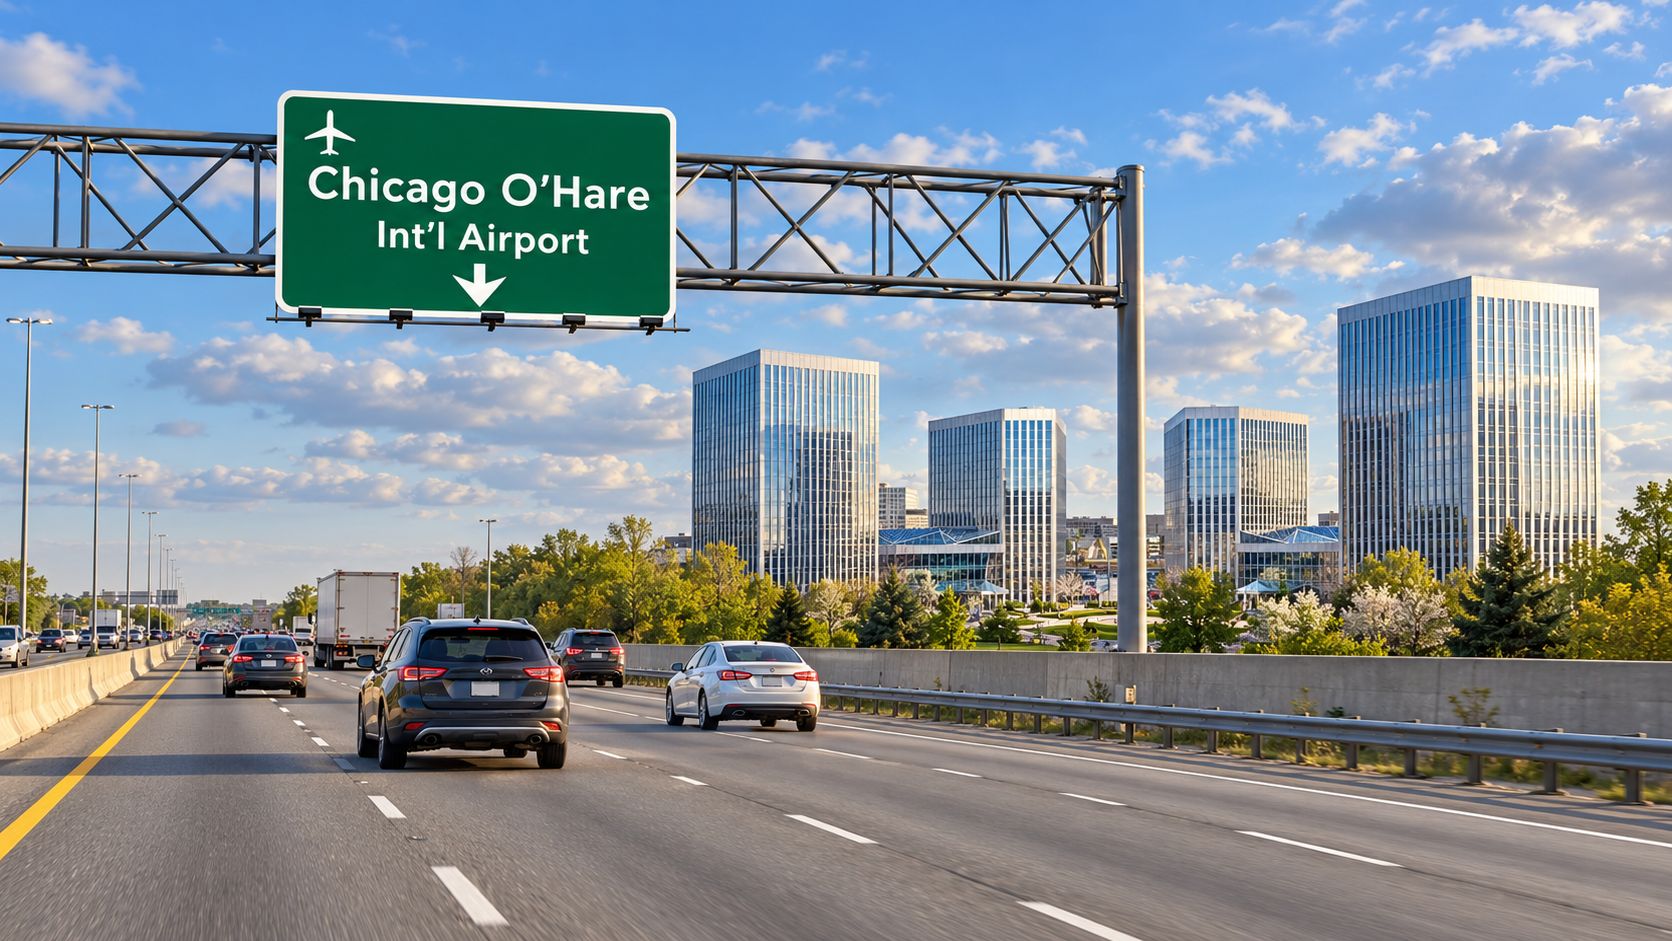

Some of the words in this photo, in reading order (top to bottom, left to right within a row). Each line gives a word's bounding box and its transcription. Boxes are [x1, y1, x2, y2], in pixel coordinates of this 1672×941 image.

[308, 165, 486, 213] Chicago
[501, 172, 650, 211] O’Hare
[378, 220, 445, 250] Int’l
[458, 222, 589, 260] Airport
